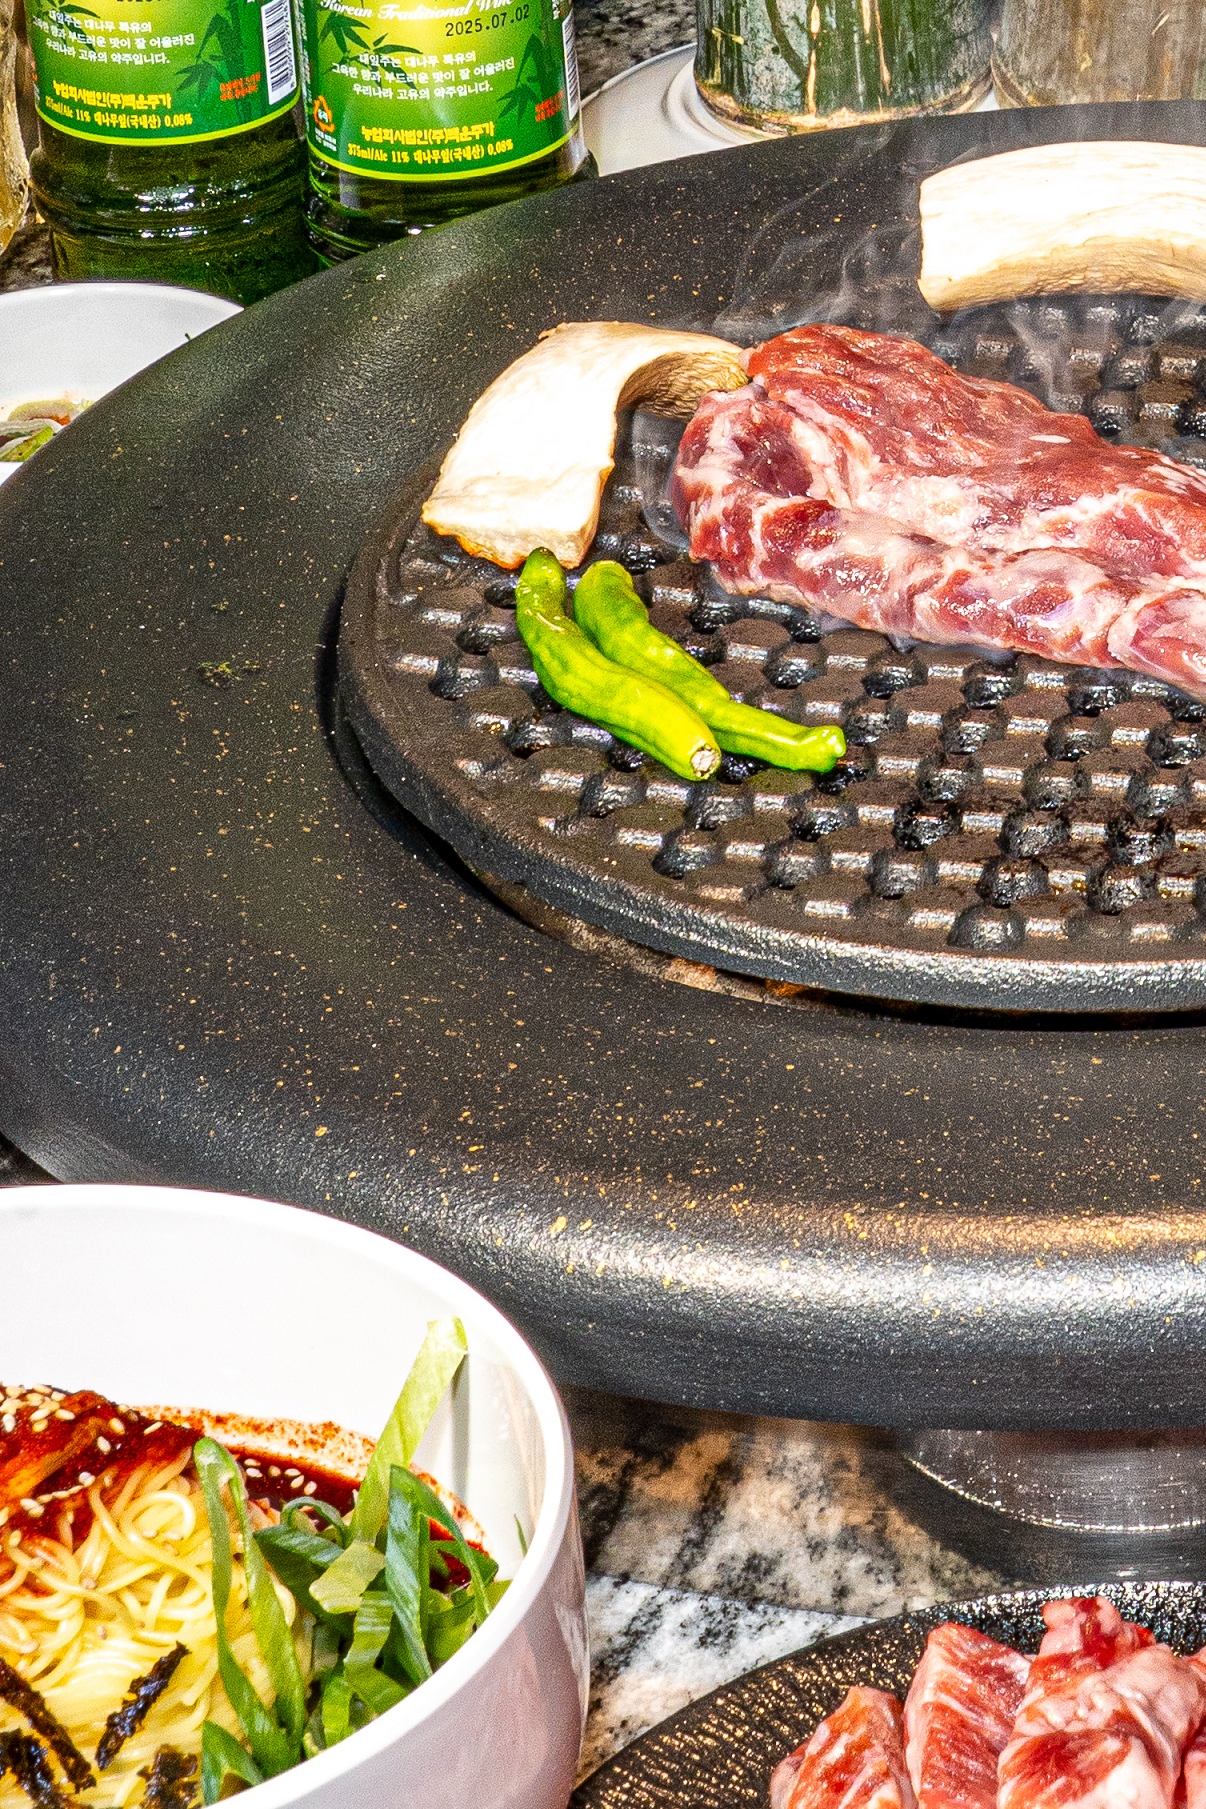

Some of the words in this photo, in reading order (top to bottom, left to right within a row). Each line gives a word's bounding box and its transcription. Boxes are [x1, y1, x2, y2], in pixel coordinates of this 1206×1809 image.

[378, 0, 474, 21] Traditional
[84, 19, 115, 33] 대나무
[118, 21, 153, 34] 특유의
[445, 3, 531, 37] 2025.07.02
[68, 29, 107, 47] 부드러운
[109, 37, 131, 49] 맛이
[134, 36, 147, 50] 잘
[45, 37, 77, 58] 우리나라
[78, 49, 108, 63] 고유의
[110, 51, 171, 66] 약주입니다.
[404, 55, 439, 68] 대나무
[443, 50, 477, 66] 특유의
[385, 70, 429, 84] 부드러운
[432, 69, 455, 84] 맛이
[458, 68, 471, 81] 잘
[353, 83, 394, 100] 우리나라
[397, 86, 430, 100] 고유의
[433, 81, 493, 99] 약주입니다.
[76, 108, 91, 122] 11%
[391, 150, 410, 163] 11%
